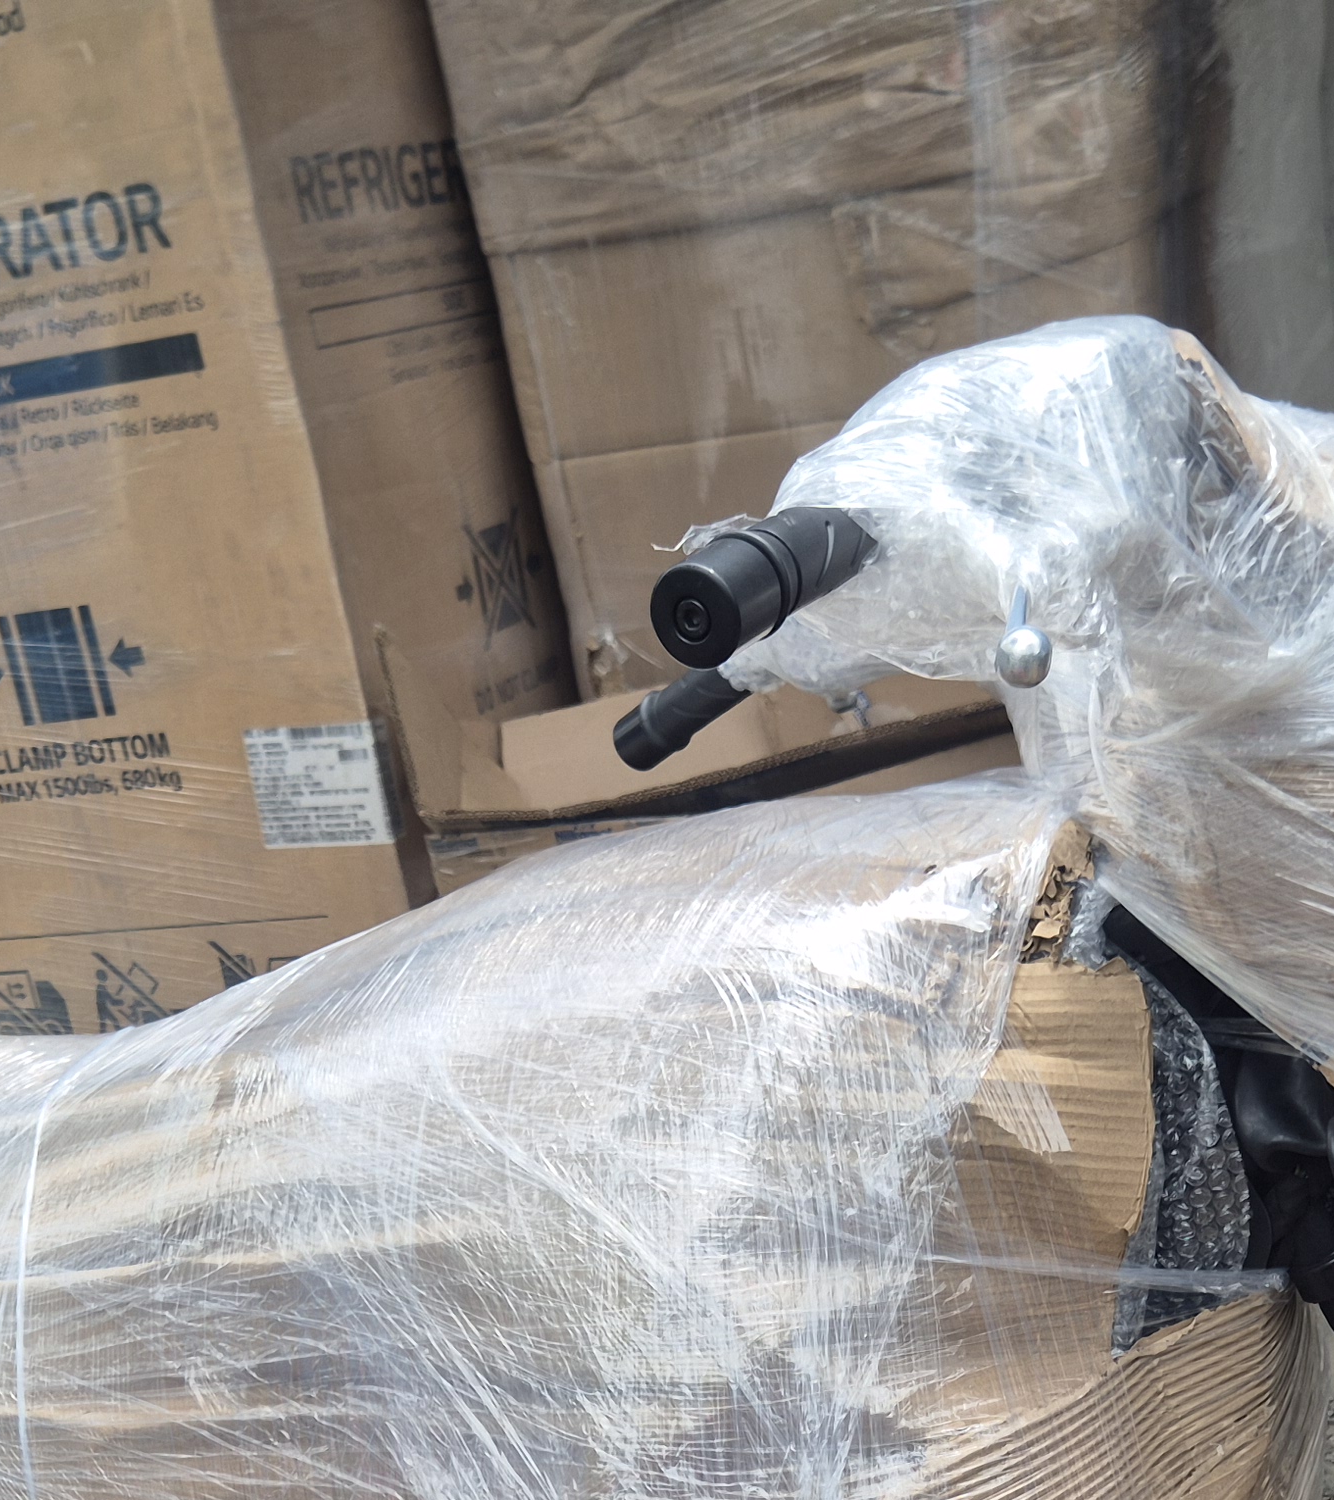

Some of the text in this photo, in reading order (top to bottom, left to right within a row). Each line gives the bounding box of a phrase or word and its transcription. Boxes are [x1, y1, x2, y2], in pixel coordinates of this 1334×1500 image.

[183, 290, 205, 313] Es
[151, 410, 219, 435] Belakang
[72, 733, 171, 767] BOTTOM
[43, 773, 119, 800] 1500lbs,
[120, 766, 183, 792] 680kg
